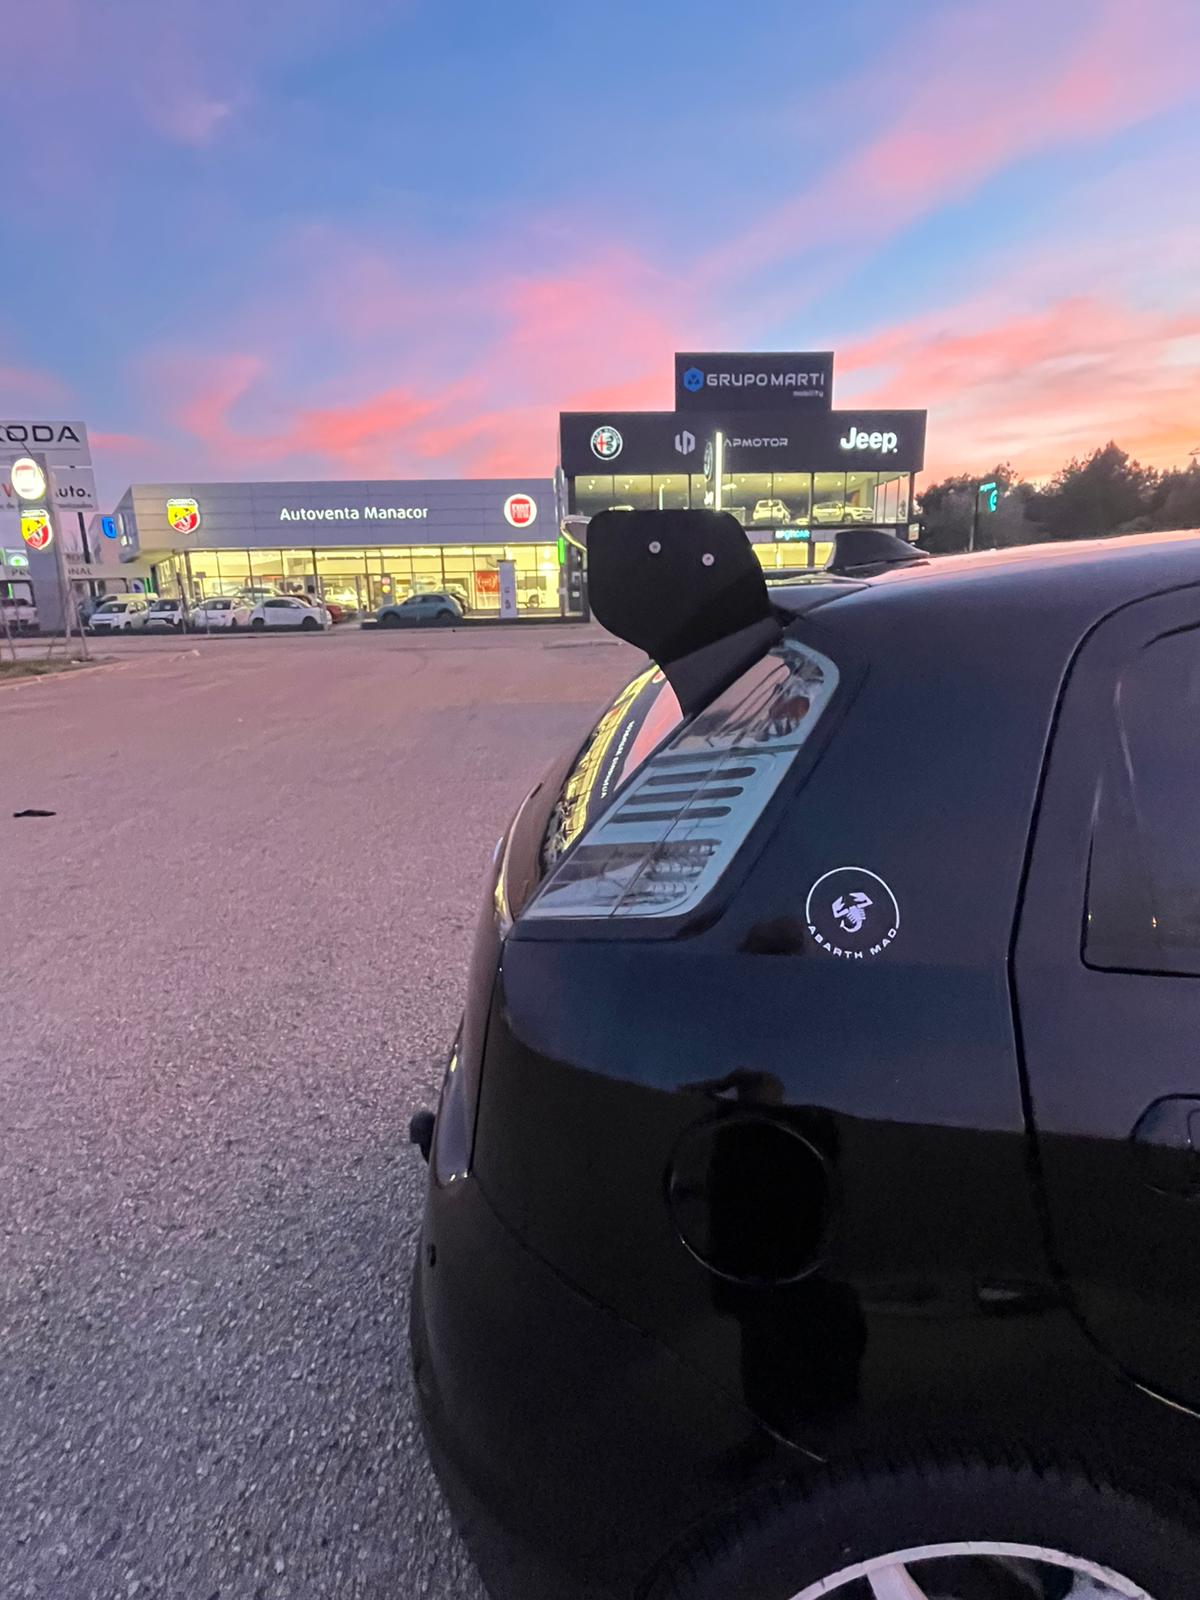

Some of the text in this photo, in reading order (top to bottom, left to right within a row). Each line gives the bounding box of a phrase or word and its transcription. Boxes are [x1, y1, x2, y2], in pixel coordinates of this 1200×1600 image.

[706, 373, 825, 387] GRUPO MARTI
[0, 425, 80, 443] ODA
[724, 437, 789, 448] APMOTOR
[279, 506, 429, 521] Autoventa Manacor
[808, 925, 897, 959] ABARTH MAD
